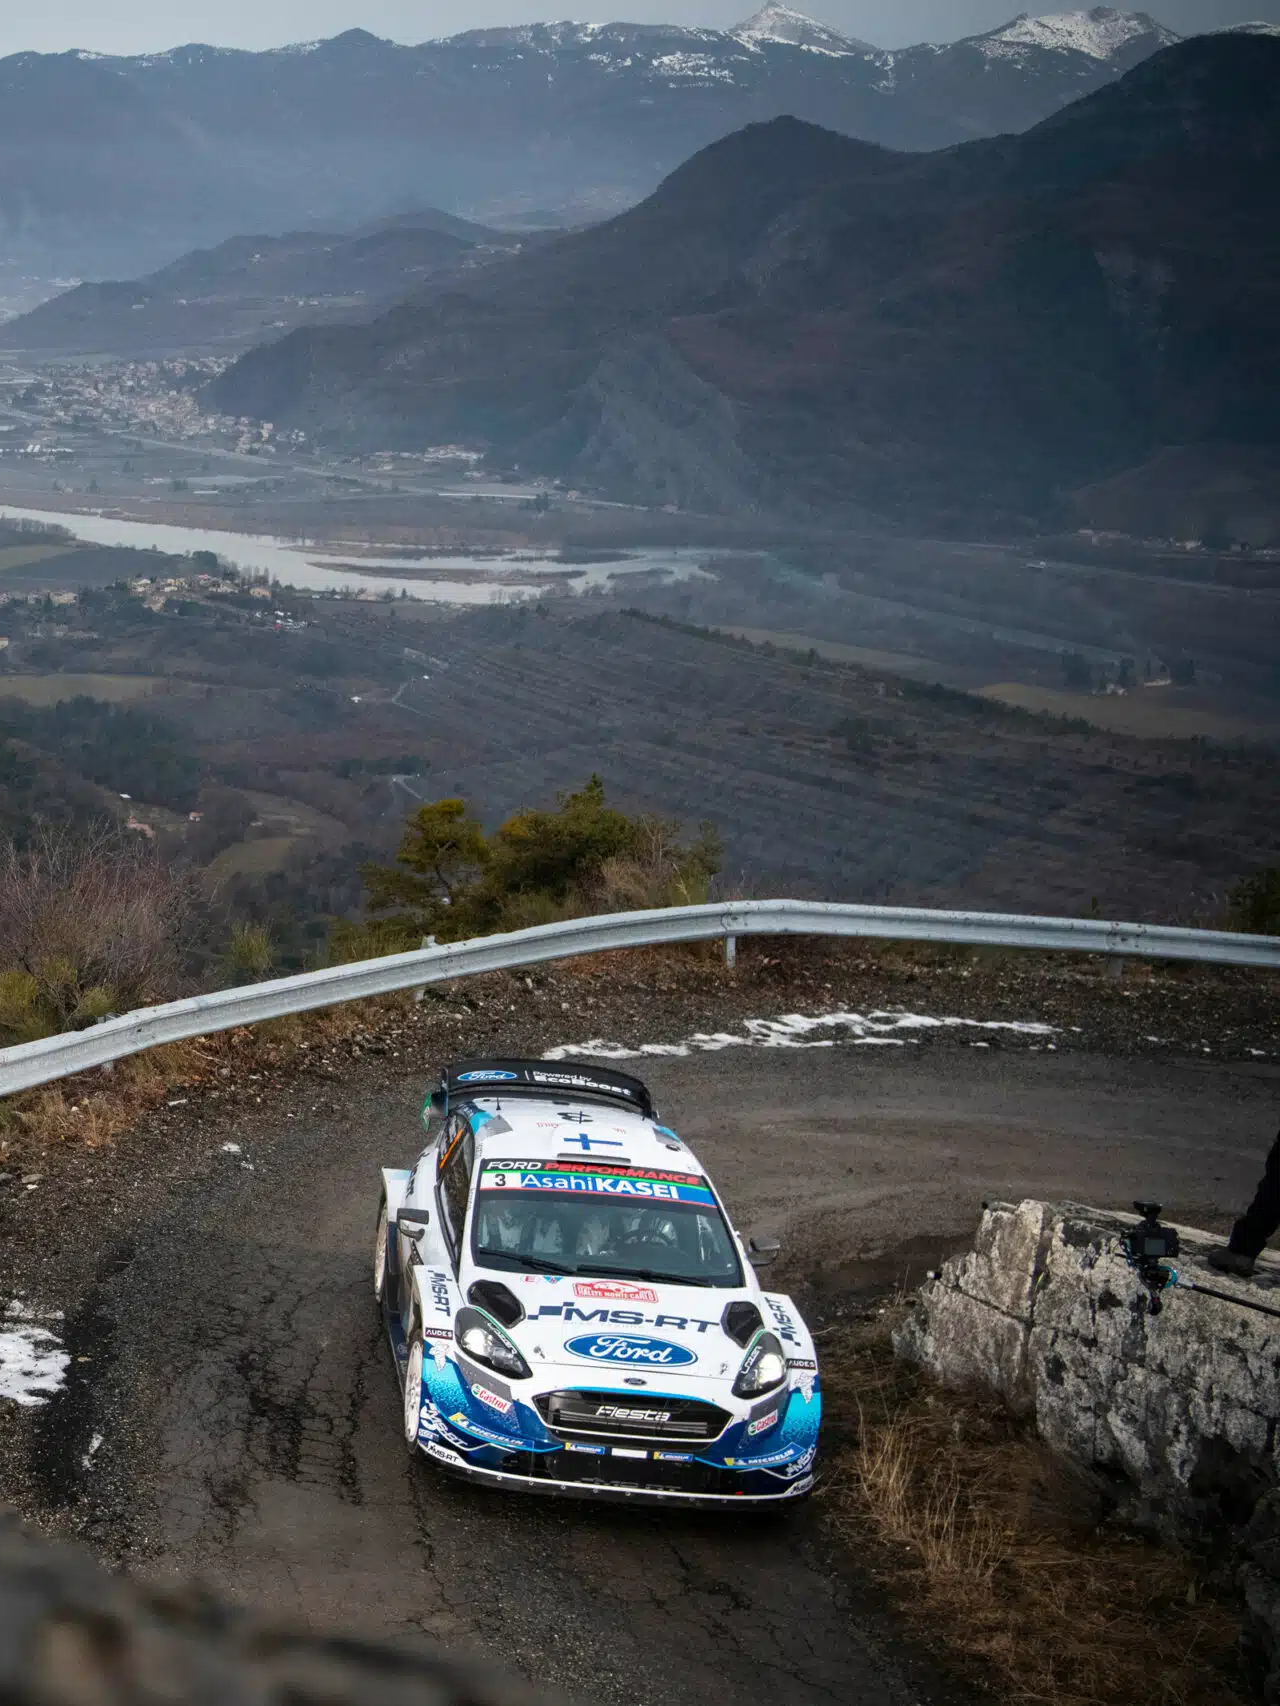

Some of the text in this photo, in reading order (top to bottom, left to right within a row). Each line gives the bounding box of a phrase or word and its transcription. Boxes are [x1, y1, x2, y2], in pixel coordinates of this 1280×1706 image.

[469, 1070, 507, 1081] Ford
[533, 1070, 592, 1082] Powered by
[533, 1075, 632, 1096] EcoBoost
[486, 1161, 700, 1185] FORD PERFORMANCE
[495, 1173, 506, 1187] 3
[563, 1307, 720, 1333] MS-RT
[589, 1335, 673, 1363] Ford
[479, 1389, 508, 1411] Castrol
[748, 1448, 795, 1465] MICHELIN
